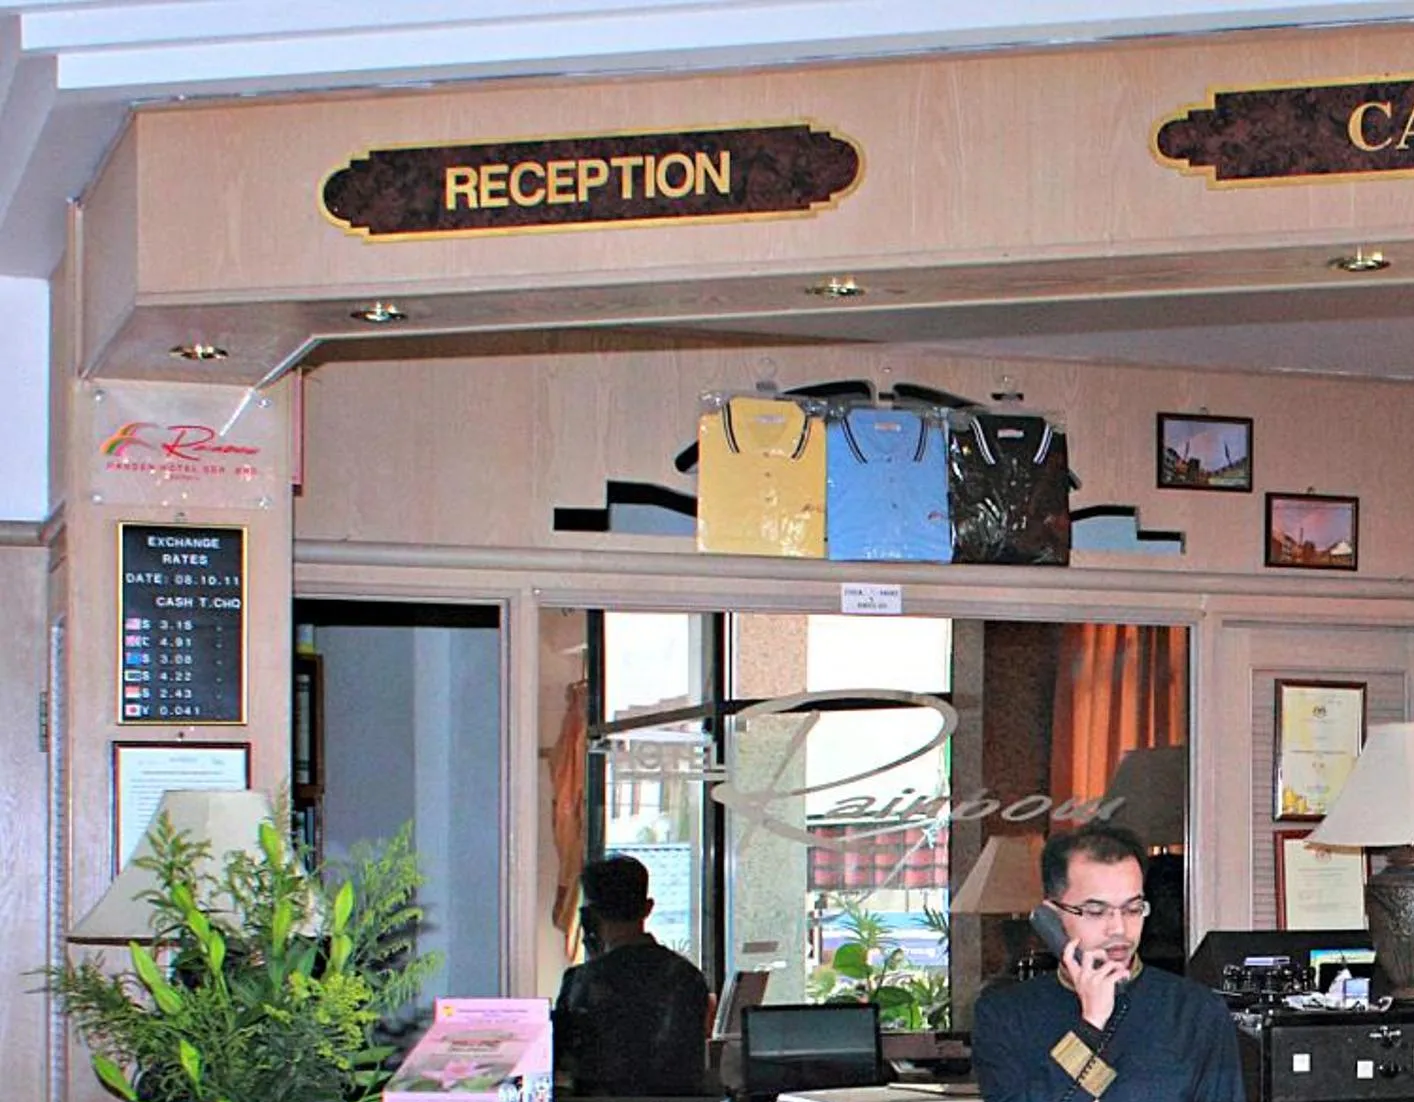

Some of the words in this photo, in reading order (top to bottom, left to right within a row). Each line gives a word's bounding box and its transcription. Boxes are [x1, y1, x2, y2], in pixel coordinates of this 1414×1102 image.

[445, 150, 731, 210] RECEPTION
[147, 536, 221, 549] EXCHANGE
[162, 553, 209, 567] RATES
[155, 596, 194, 608] CASH
[711, 687, 1128, 852] Rainbow
